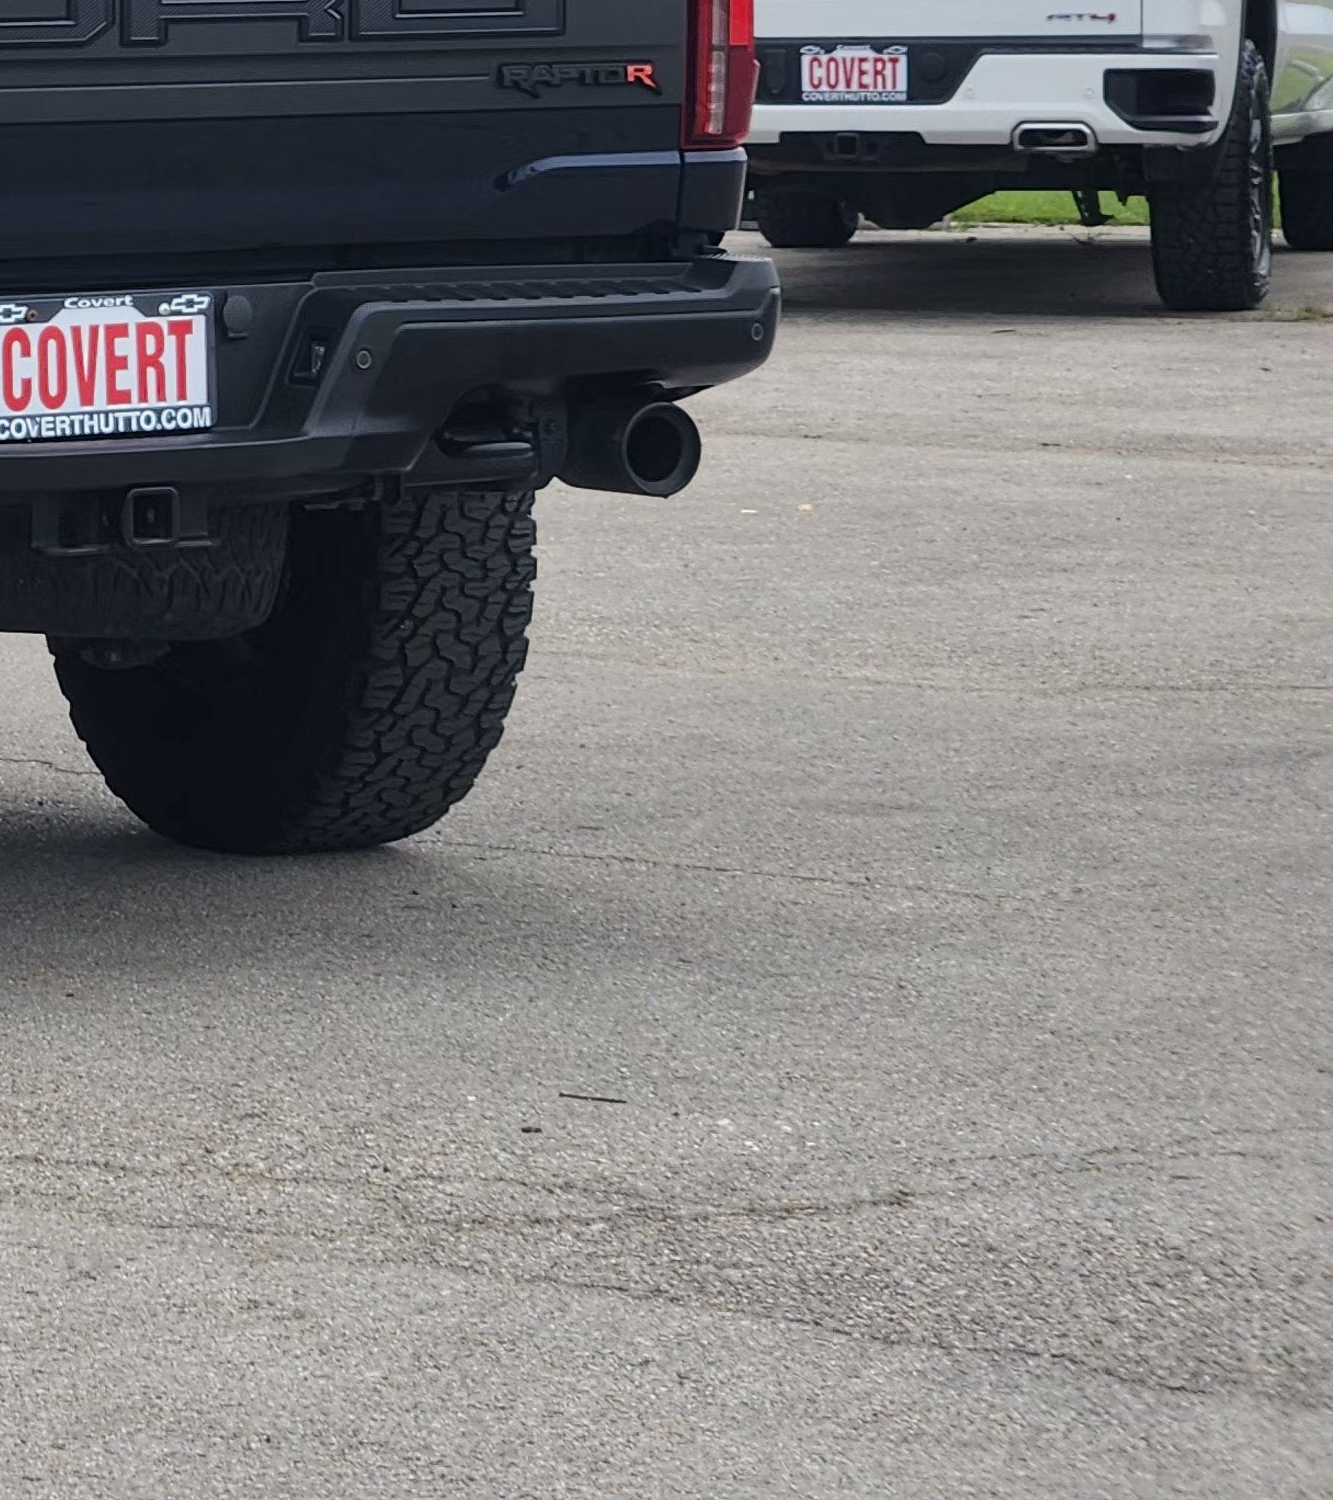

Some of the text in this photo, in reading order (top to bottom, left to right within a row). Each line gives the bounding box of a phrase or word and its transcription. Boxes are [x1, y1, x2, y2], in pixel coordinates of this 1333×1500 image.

[499, 61, 661, 98] RAPTOR
[809, 56, 900, 90] COVERT
[63, 295, 134, 309] Covert
[1, 319, 193, 412] COVERT
